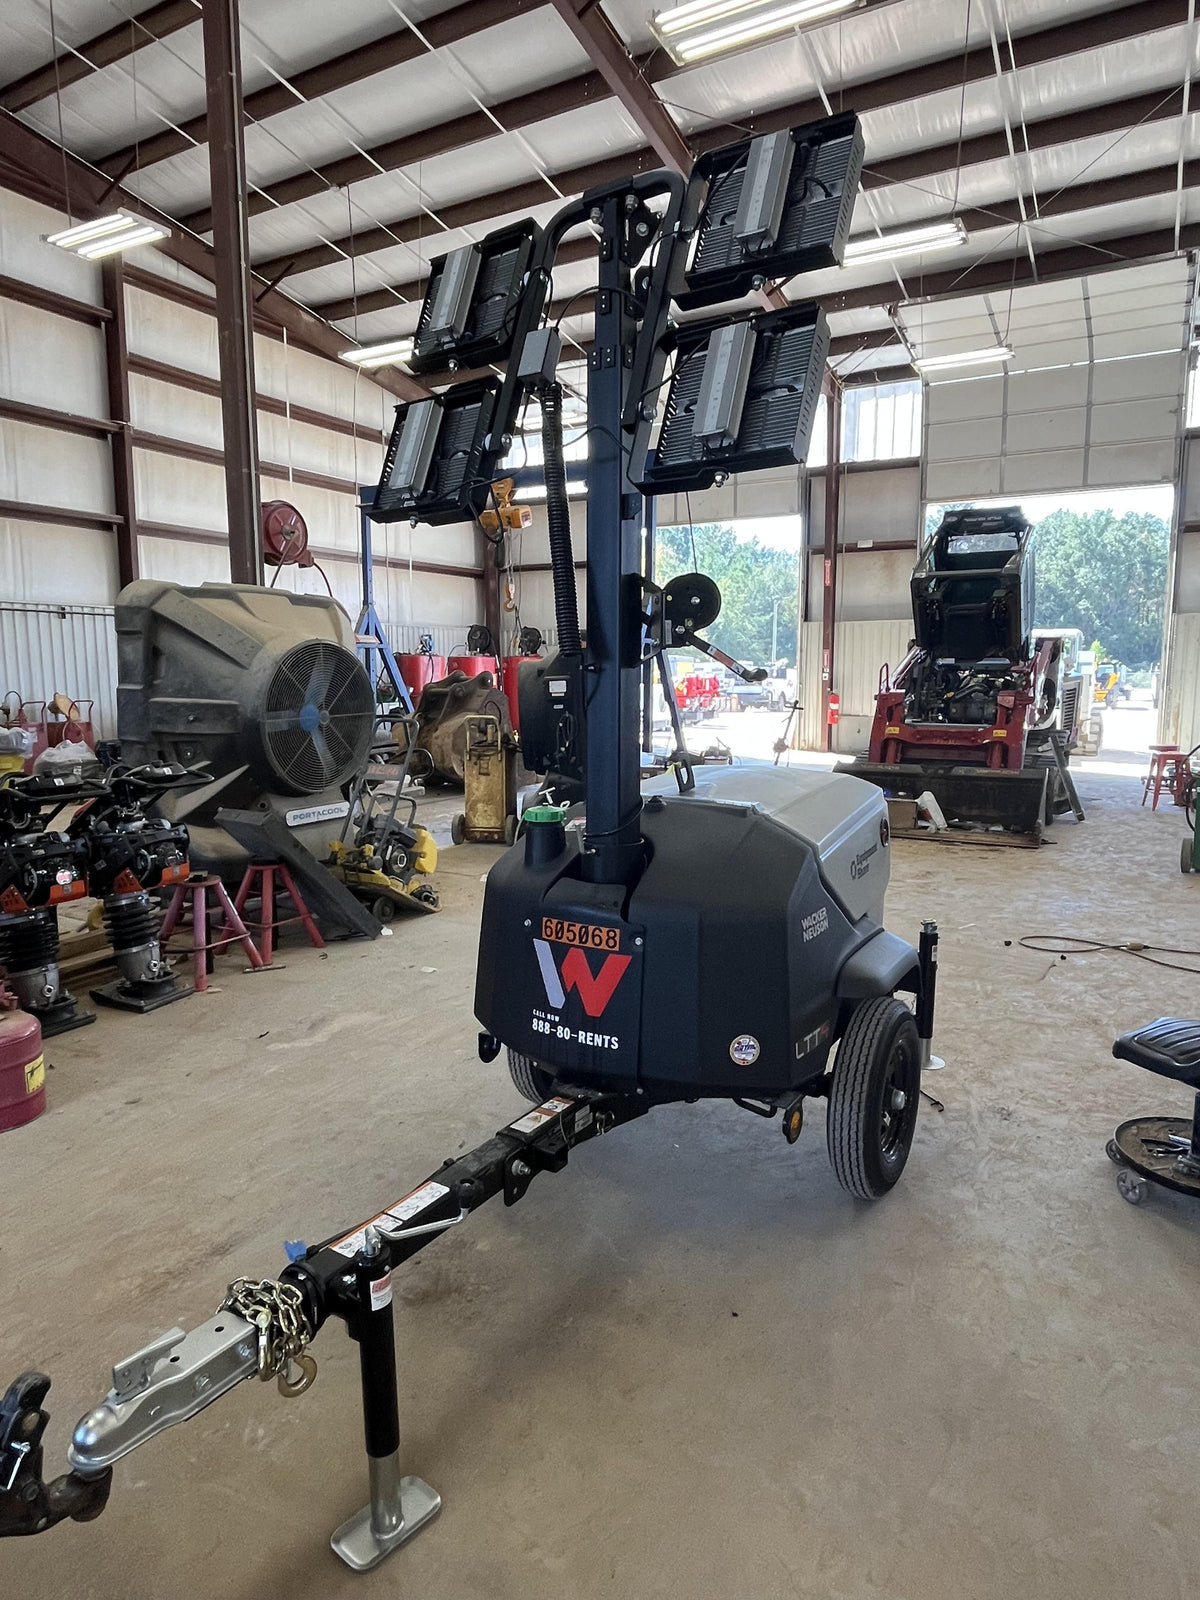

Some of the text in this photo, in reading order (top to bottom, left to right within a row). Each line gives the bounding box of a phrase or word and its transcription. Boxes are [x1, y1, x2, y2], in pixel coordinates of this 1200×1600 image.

[292, 806, 346, 822] PORTACOOL
[801, 906, 828, 930] WACKER
[543, 918, 618, 950] 605068
[802, 918, 829, 943] NEUSON
[532, 1008, 546, 1019] CALL
[531, 1018, 619, 1050] 888-80-RENTS
